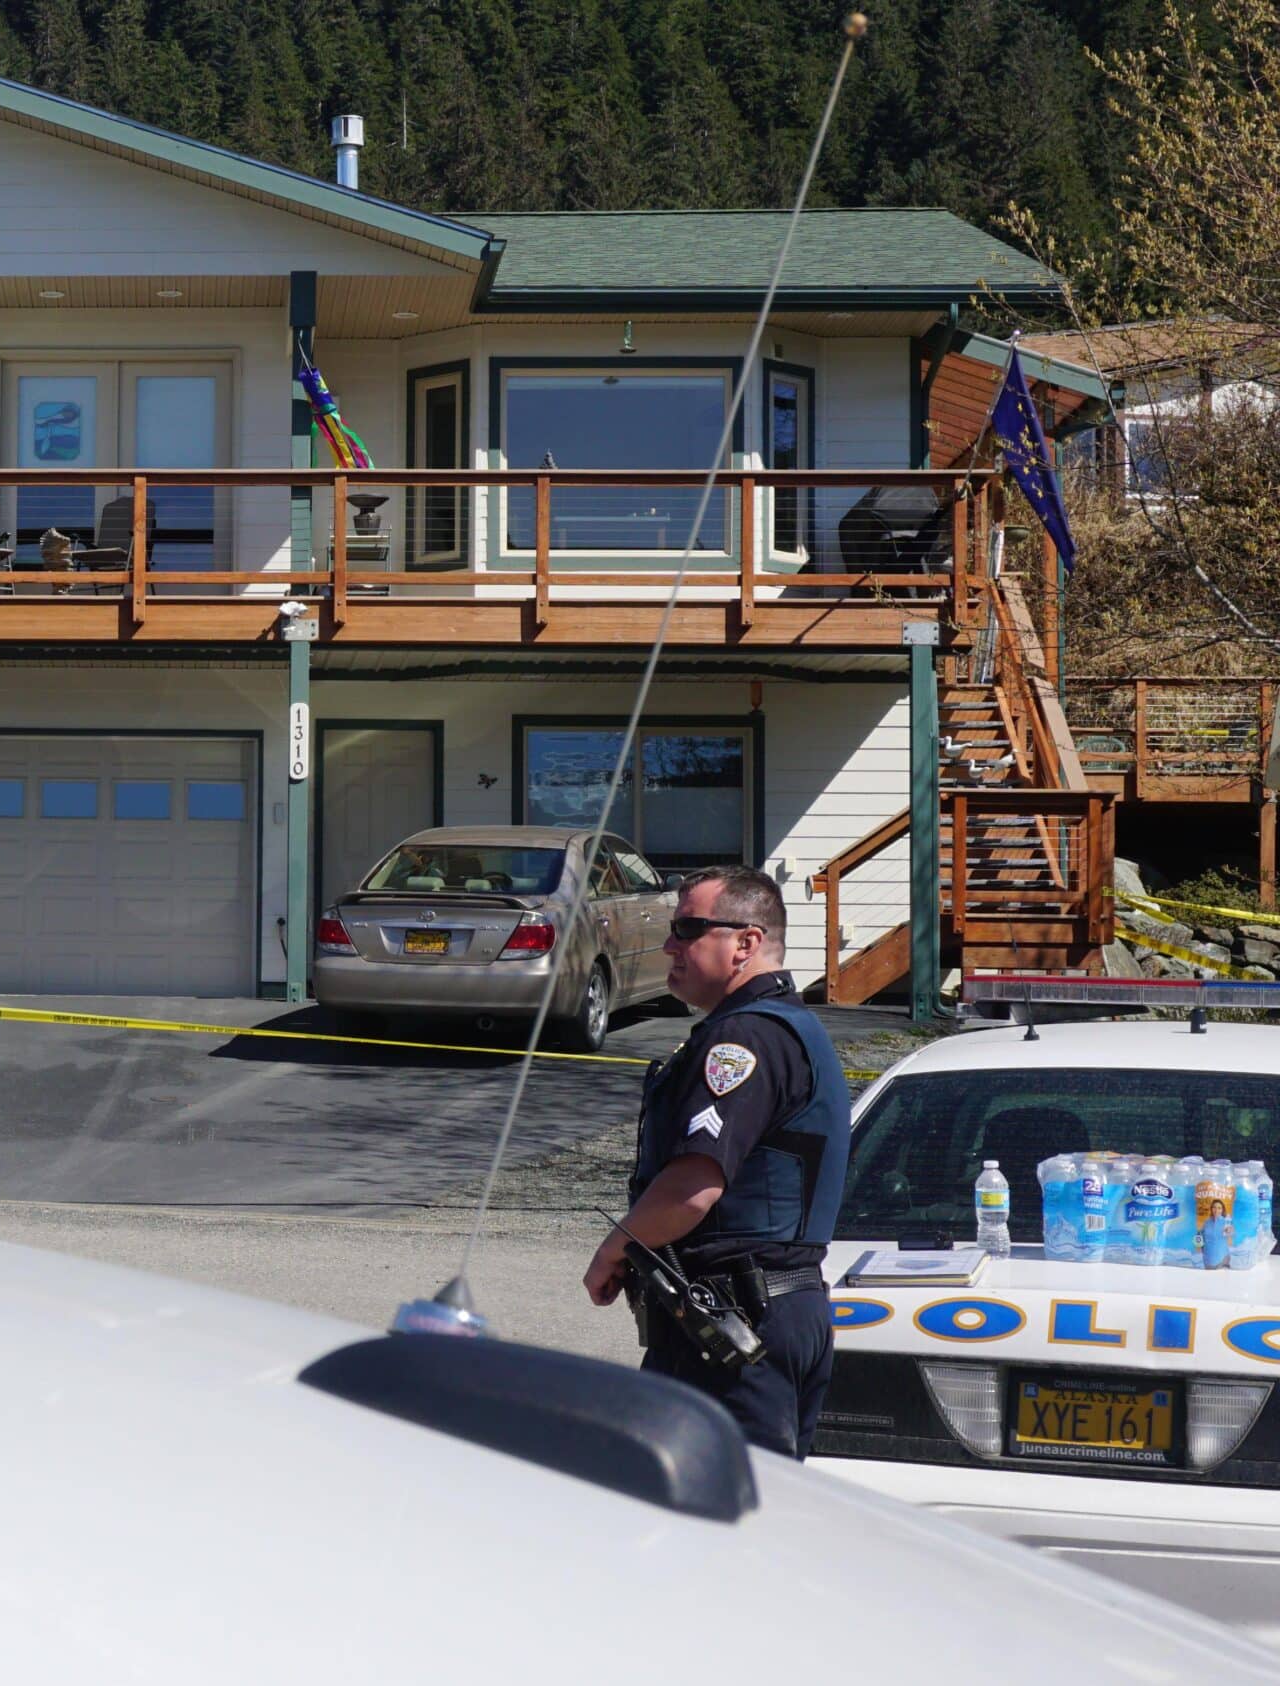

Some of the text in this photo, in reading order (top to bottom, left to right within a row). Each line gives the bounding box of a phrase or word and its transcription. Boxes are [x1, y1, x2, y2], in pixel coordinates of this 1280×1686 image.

[293, 707, 304, 776] 1310
[1153, 1205, 1175, 1217] Life
[1055, 1390, 1139, 1405] ALASKA
[1031, 1400, 1154, 1446] XYE 161
[1019, 1441, 1167, 1462] juneaucrimeline.com
